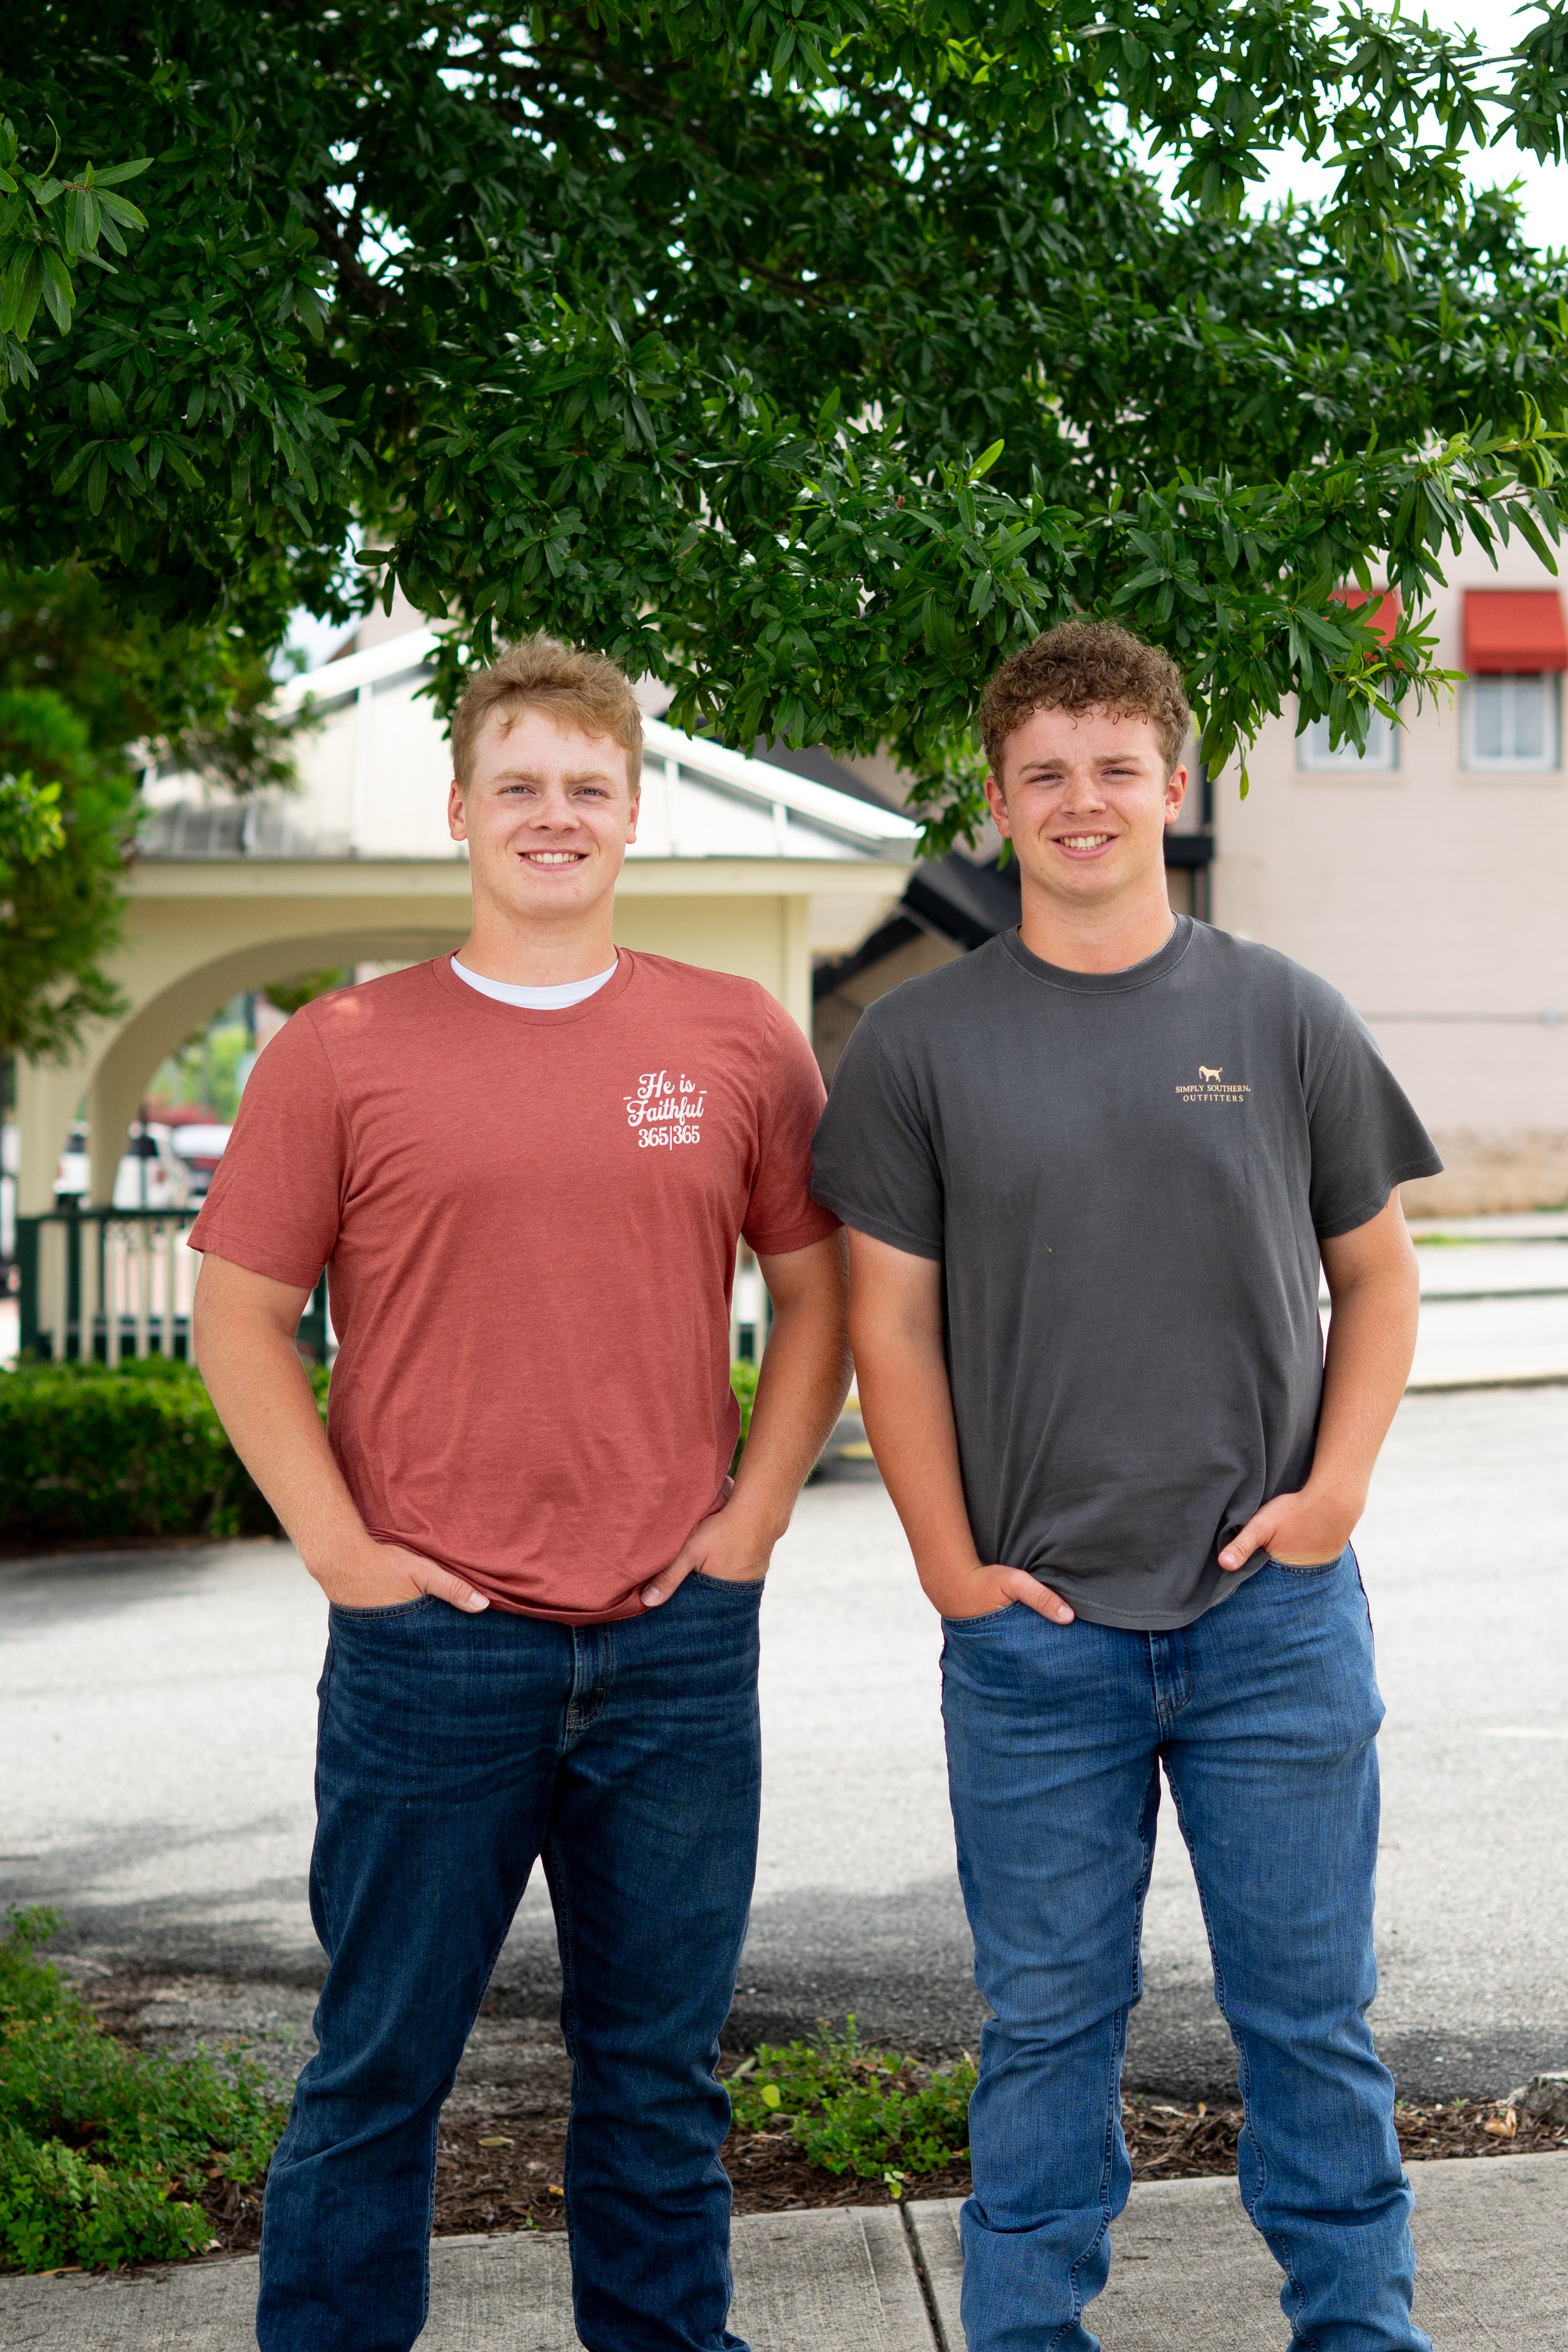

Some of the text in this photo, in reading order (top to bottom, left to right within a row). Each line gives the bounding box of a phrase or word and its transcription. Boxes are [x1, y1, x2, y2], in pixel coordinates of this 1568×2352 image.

[637, 1070, 696, 1099] He is
[1175, 1085, 1204, 1093] SIMPLY
[626, 1097, 705, 1127] Faithful
